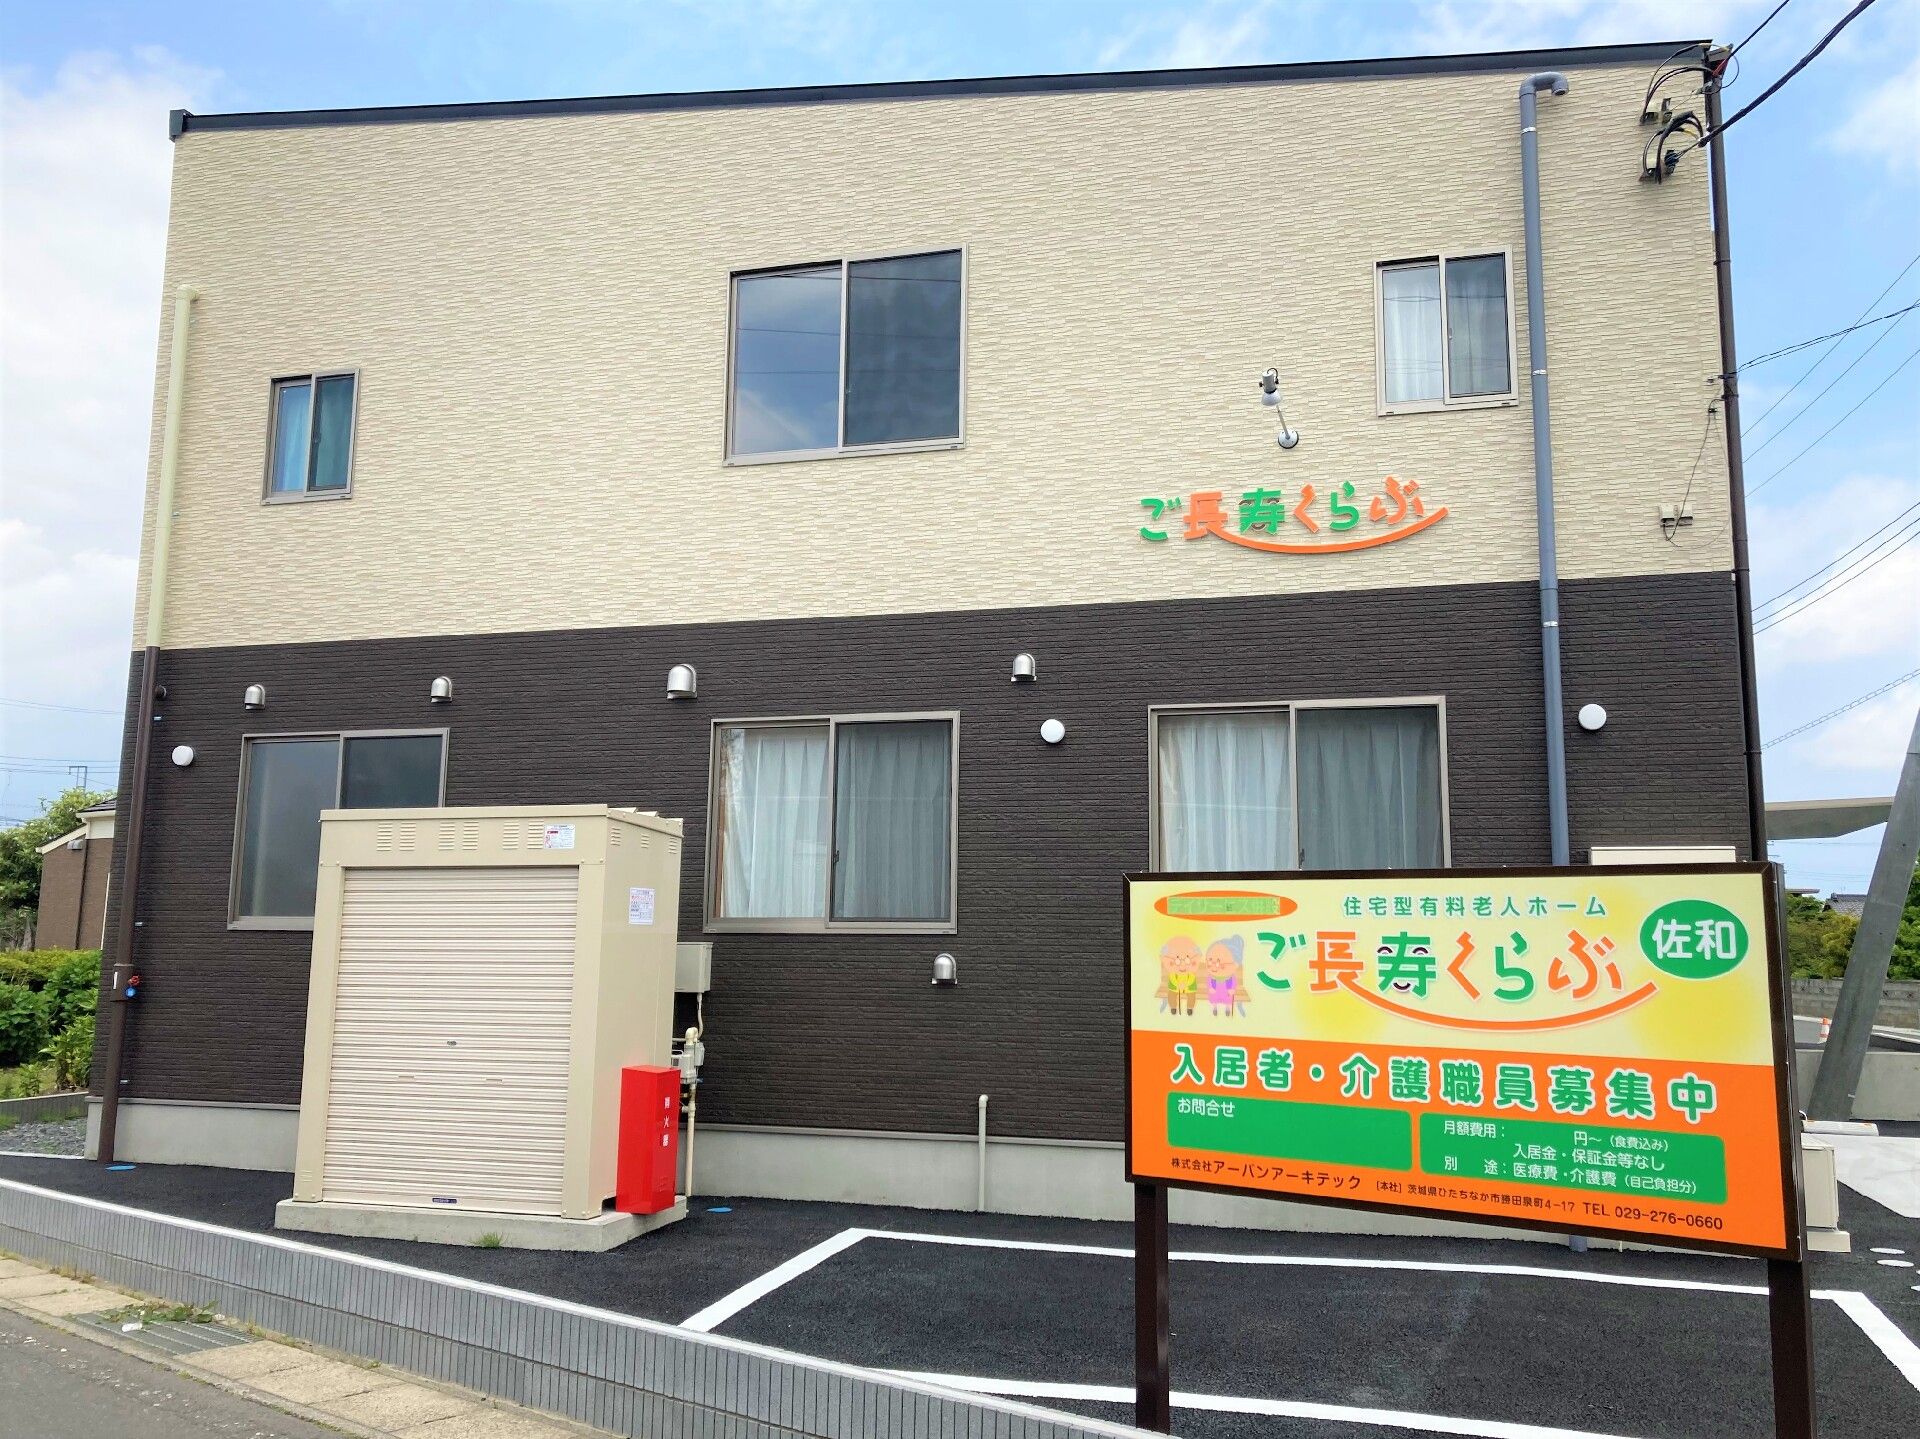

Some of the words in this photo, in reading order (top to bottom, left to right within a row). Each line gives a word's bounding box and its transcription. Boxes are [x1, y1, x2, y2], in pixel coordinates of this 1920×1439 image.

[1140, 476, 1448, 553] ご長寿くらぶ
[1343, 896, 1606, 917] 住宅型有料老人ホーム
[1652, 918, 1737, 961] 佐和
[1256, 929, 1658, 1029] ご長寿くらぶ
[1170, 1043, 1716, 1124] 入居者・介護職員募集中
[1177, 1098, 1235, 1118] お問合せ
[1513, 1143, 1665, 1171] 入居金・保証金等なし
[1171, 1157, 1361, 1190] 株式会社アーバンアーキテック
[1583, 1201, 1610, 1217] TEL
[1614, 1205, 1723, 1230] 029-276-0660
